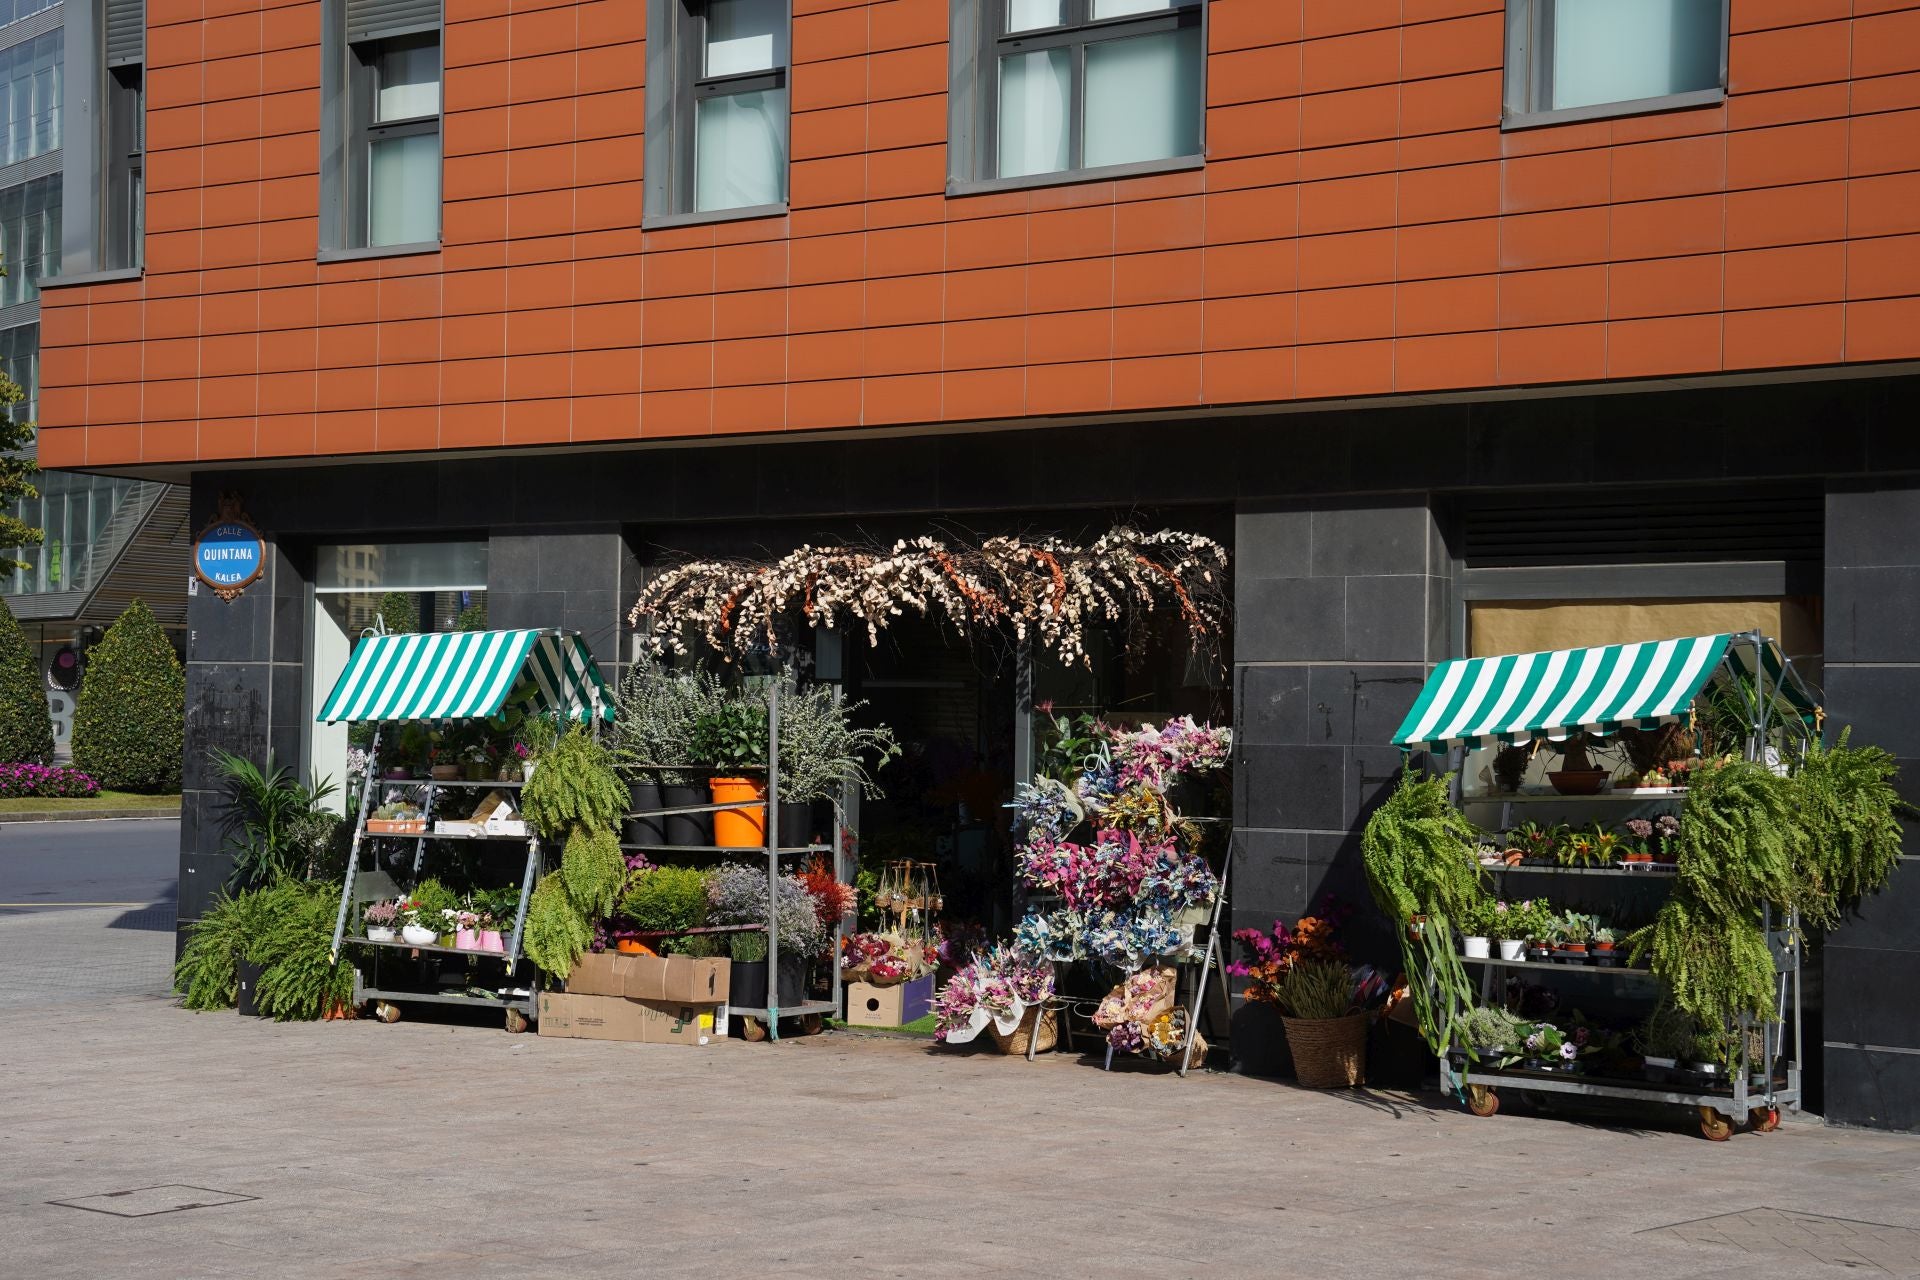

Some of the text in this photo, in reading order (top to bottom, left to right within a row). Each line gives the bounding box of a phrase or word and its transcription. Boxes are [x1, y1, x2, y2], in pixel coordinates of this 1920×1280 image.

[217, 528, 242, 537] CALLE
[204, 548, 253, 560] QUINTANA
[215, 572, 242, 582] KALEA
